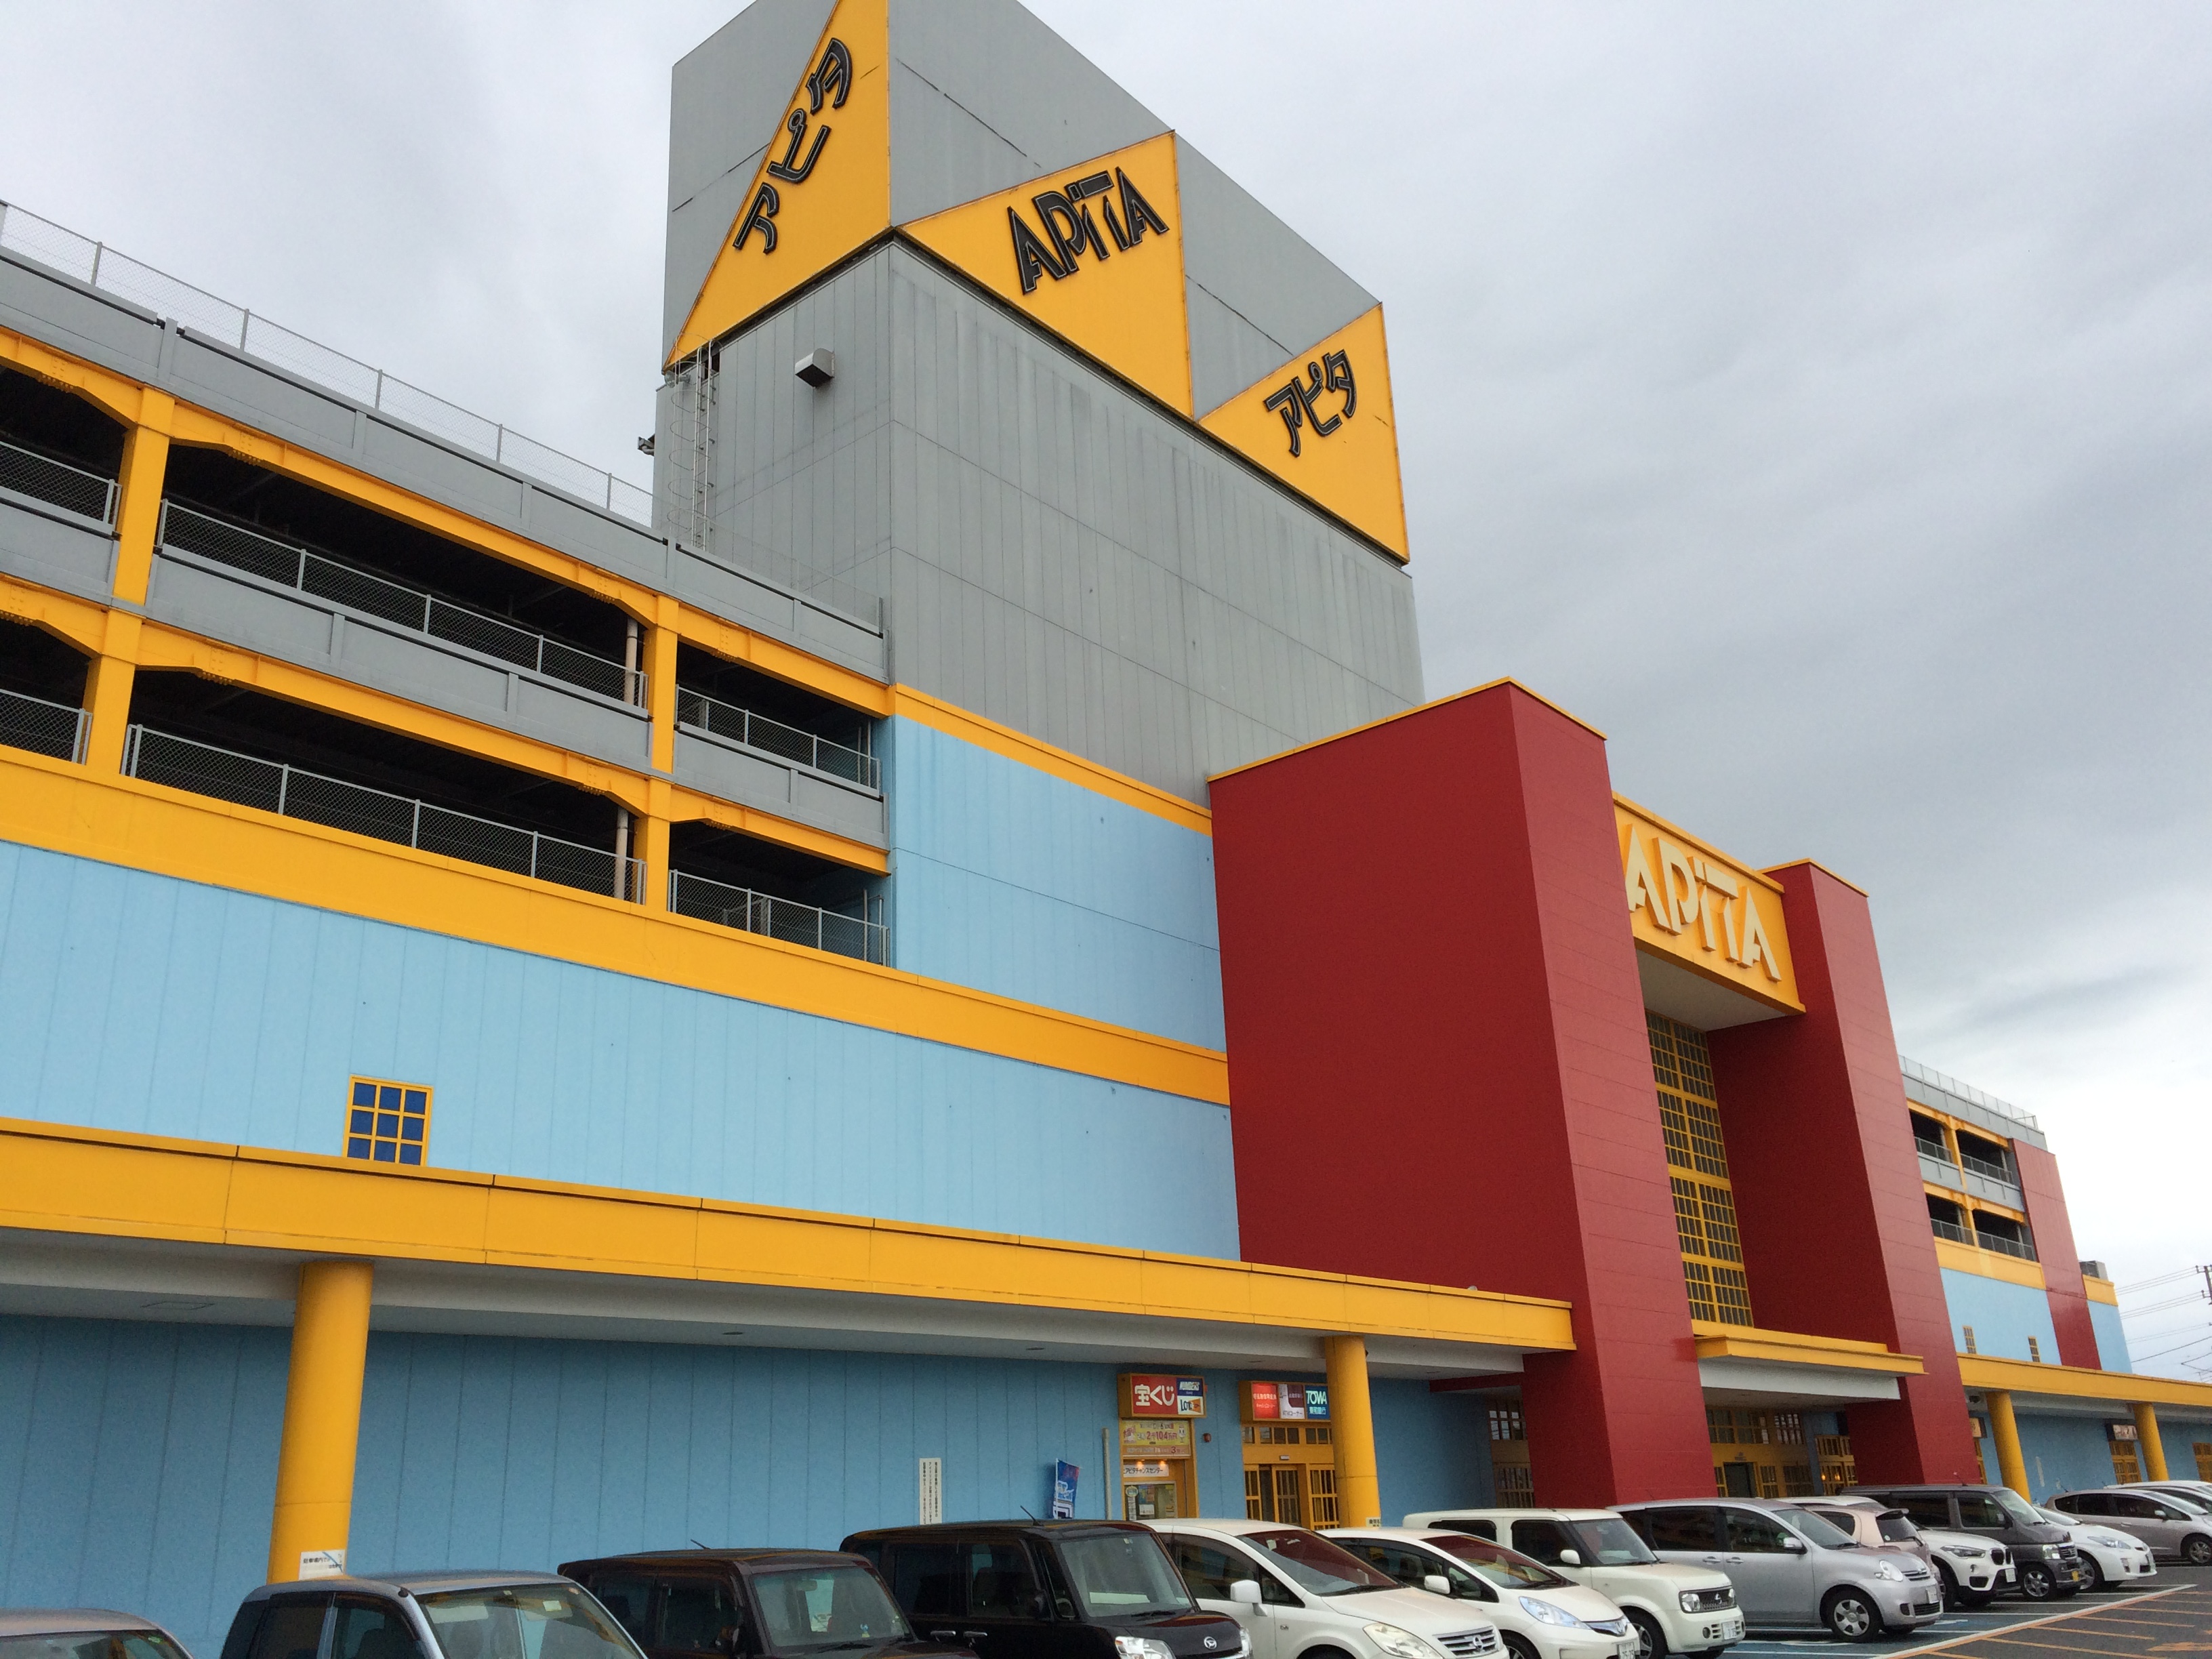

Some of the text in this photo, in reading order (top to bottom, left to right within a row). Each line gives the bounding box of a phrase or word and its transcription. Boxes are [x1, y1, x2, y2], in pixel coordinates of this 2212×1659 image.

[733, 37, 853, 254] アピタ
[1007, 166, 1170, 295] APITA
[1263, 348, 1357, 457] アピタ
[1625, 824, 1782, 983] APITA
[1134, 1384, 1175, 1406] 宝くじ
[1305, 1391, 1328, 1405] TOWA
